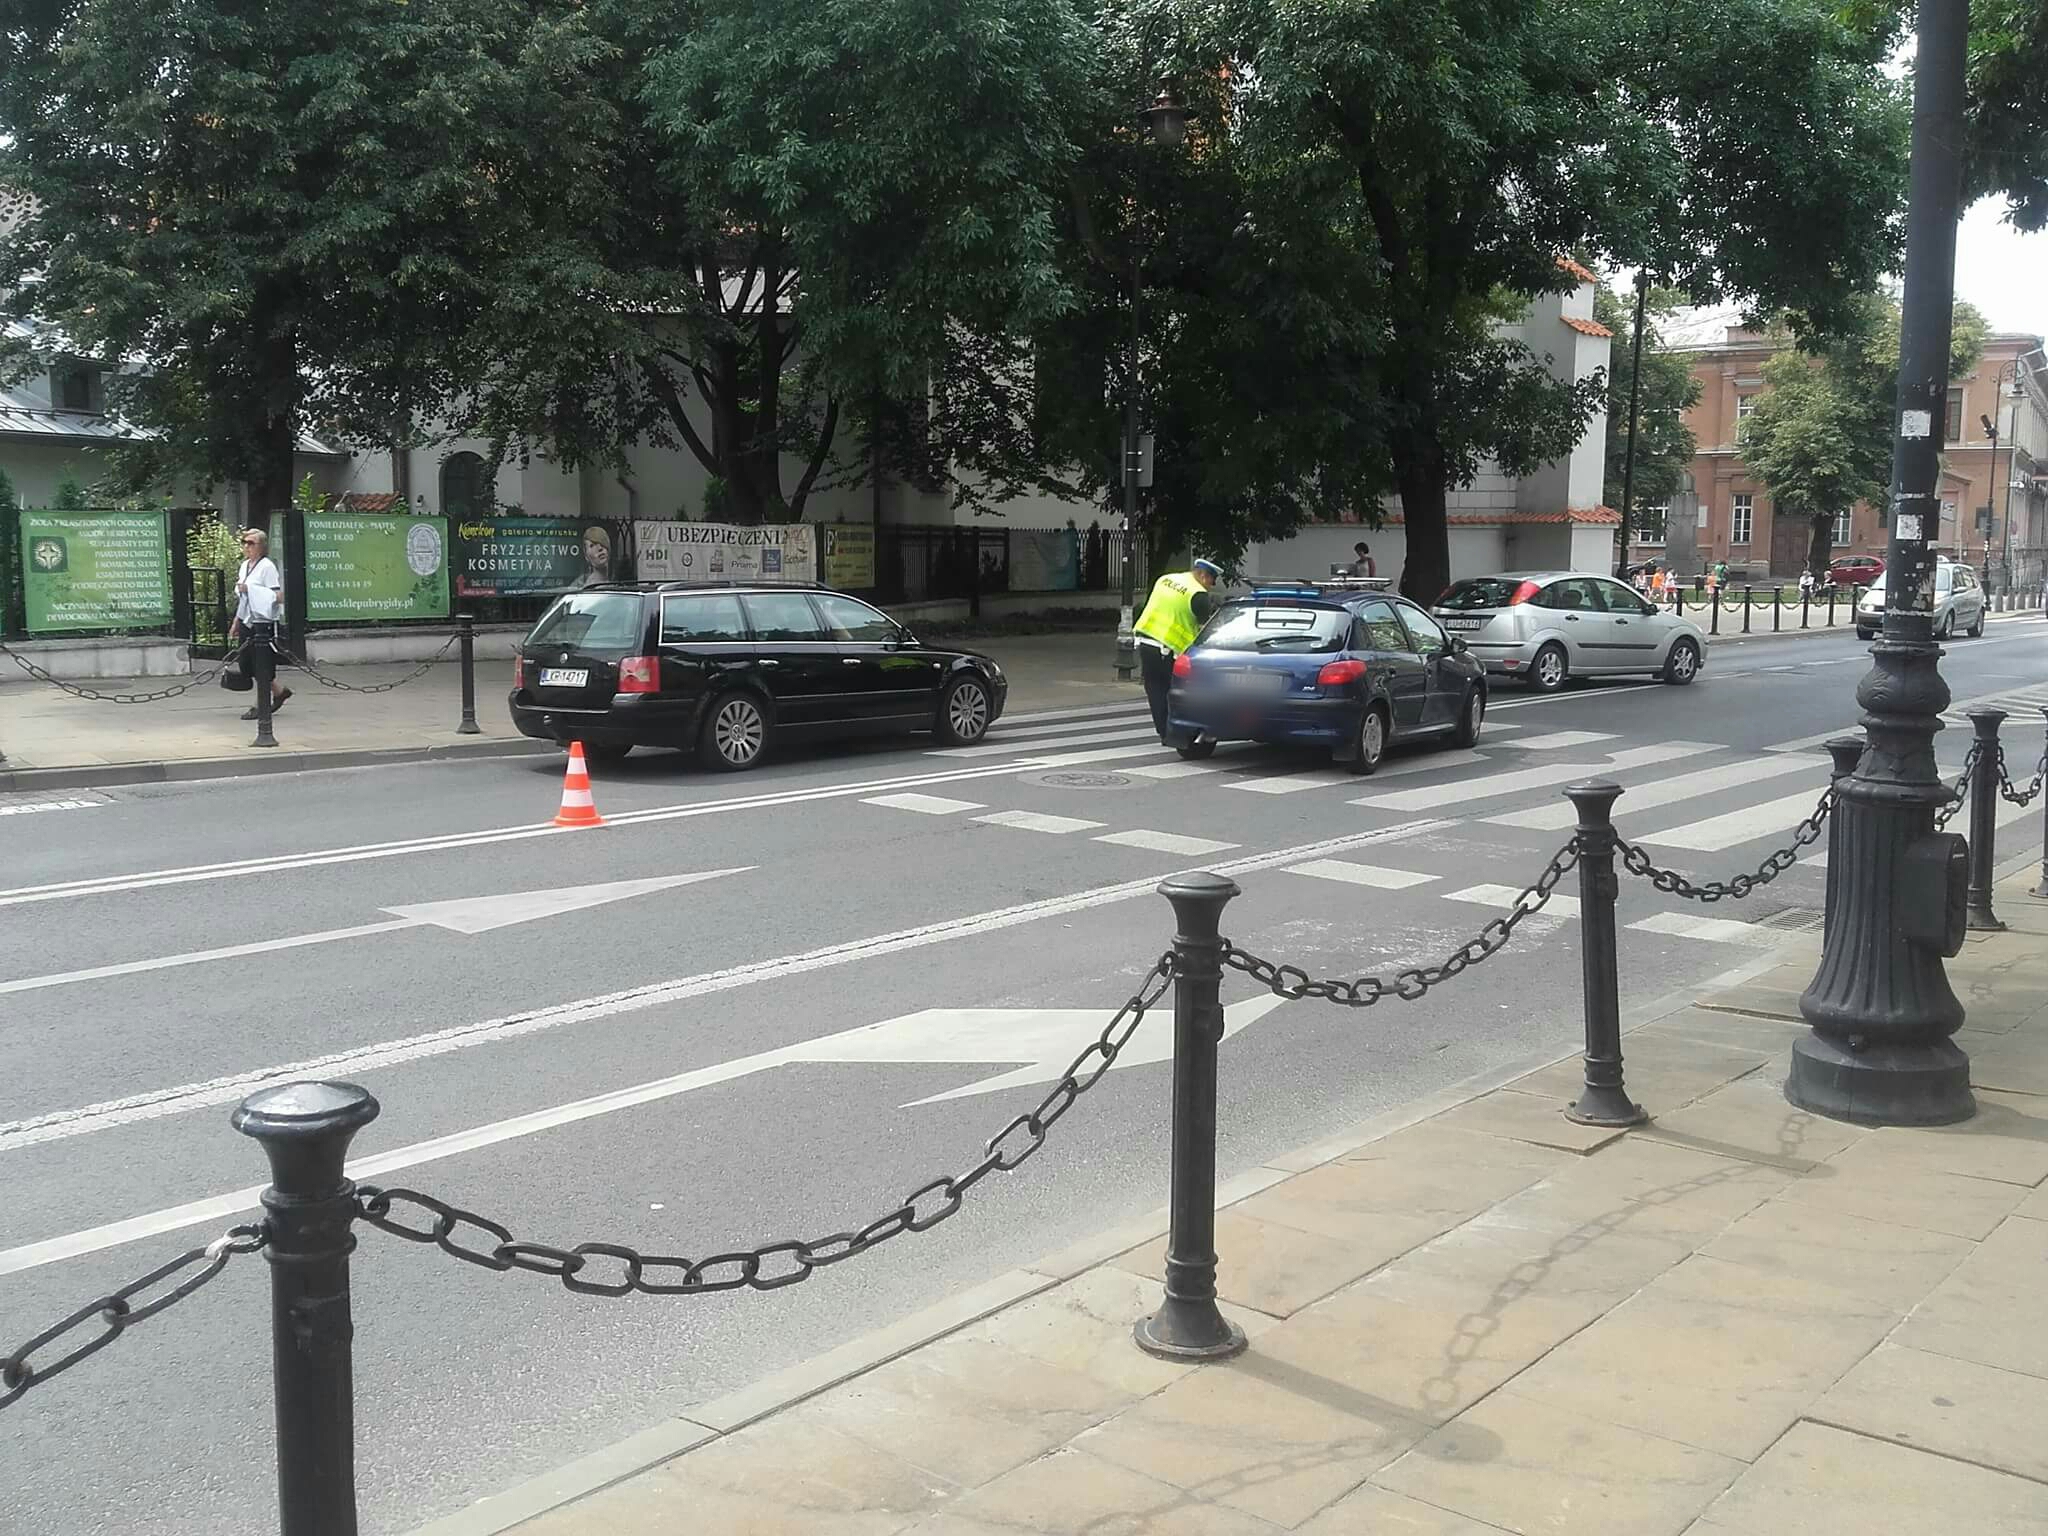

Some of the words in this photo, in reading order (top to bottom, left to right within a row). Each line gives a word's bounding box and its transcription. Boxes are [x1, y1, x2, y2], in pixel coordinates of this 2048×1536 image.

[537, 529, 578, 537] wizerunku
[309, 551, 341, 559] SOBOTA
[481, 543, 580, 556] FRYZJERSTWO
[646, 549, 668, 560] HDI
[468, 559, 553, 571] KOSMETYKA
[312, 598, 414, 611] www.sklepubrygidy.pl
